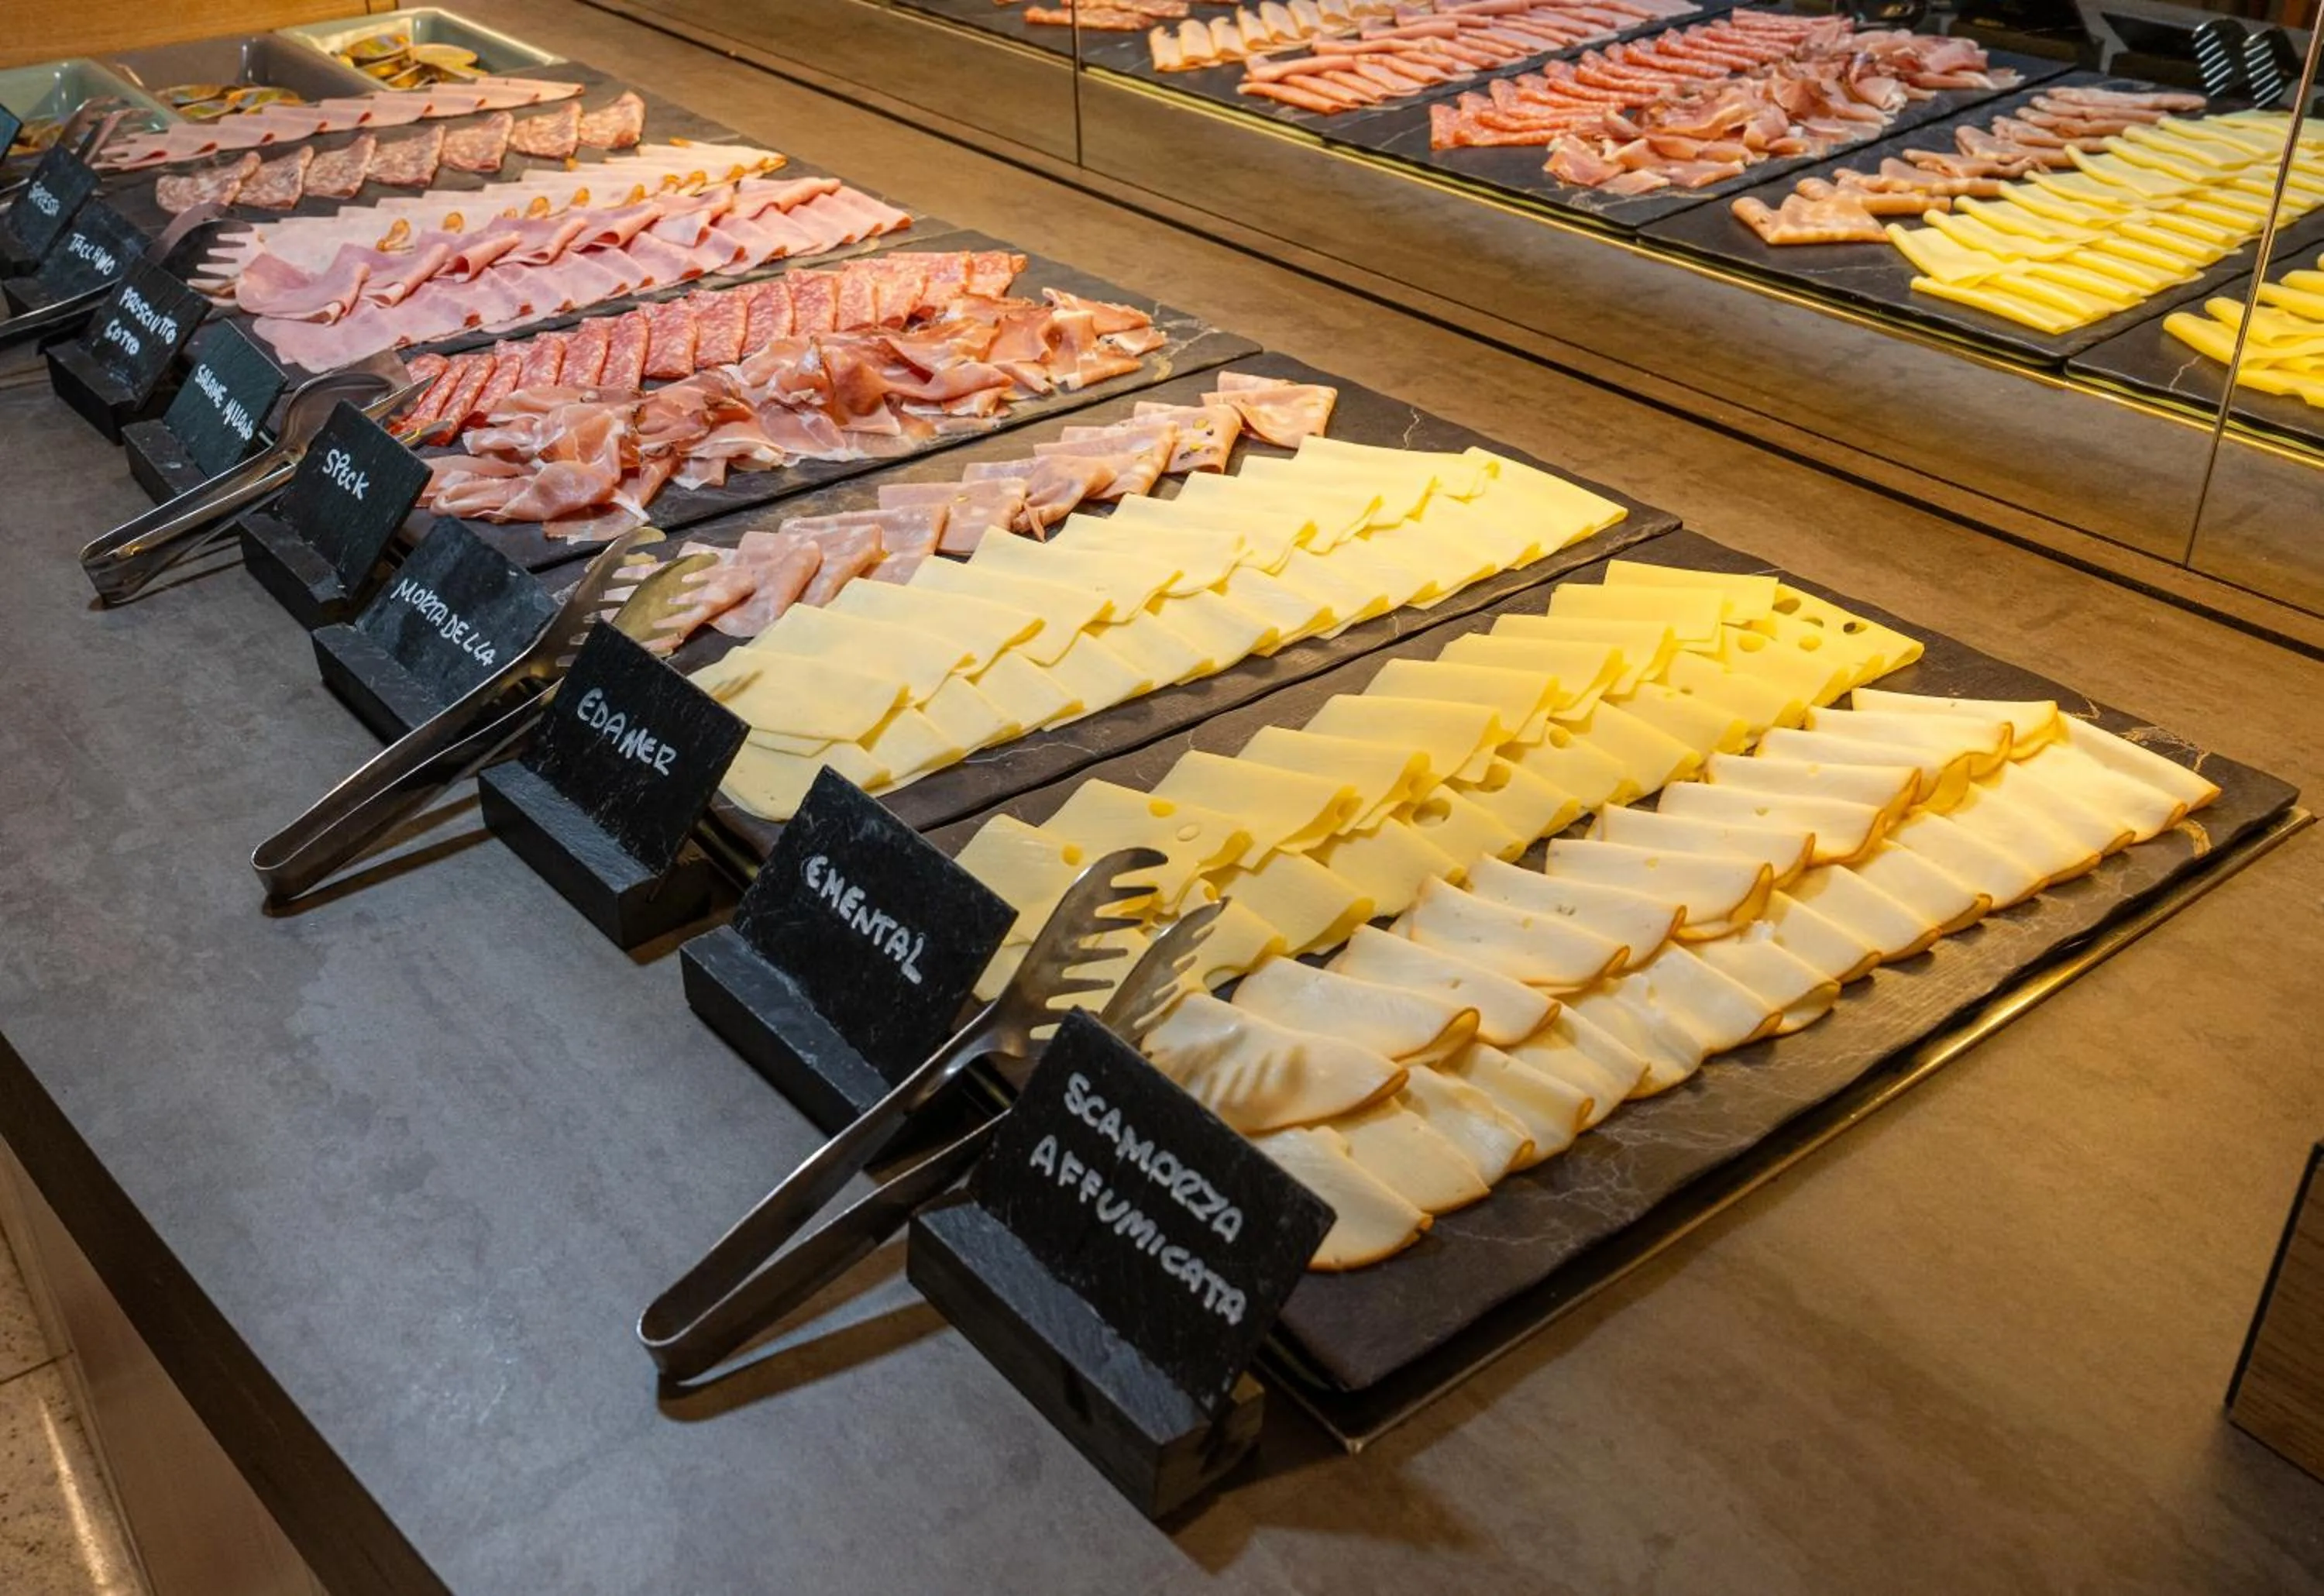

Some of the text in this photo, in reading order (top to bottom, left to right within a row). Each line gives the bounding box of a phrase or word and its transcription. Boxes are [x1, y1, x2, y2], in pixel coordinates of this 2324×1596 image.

[104, 318, 140, 356] COTTO
[119, 286, 177, 344] PROSCIUTTO
[390, 578, 497, 667] MORTADELLA
[577, 688, 677, 776] EDAMER
[803, 855, 926, 985] EMENTAL
[1030, 1134, 1246, 1326] AFFUMICATA
